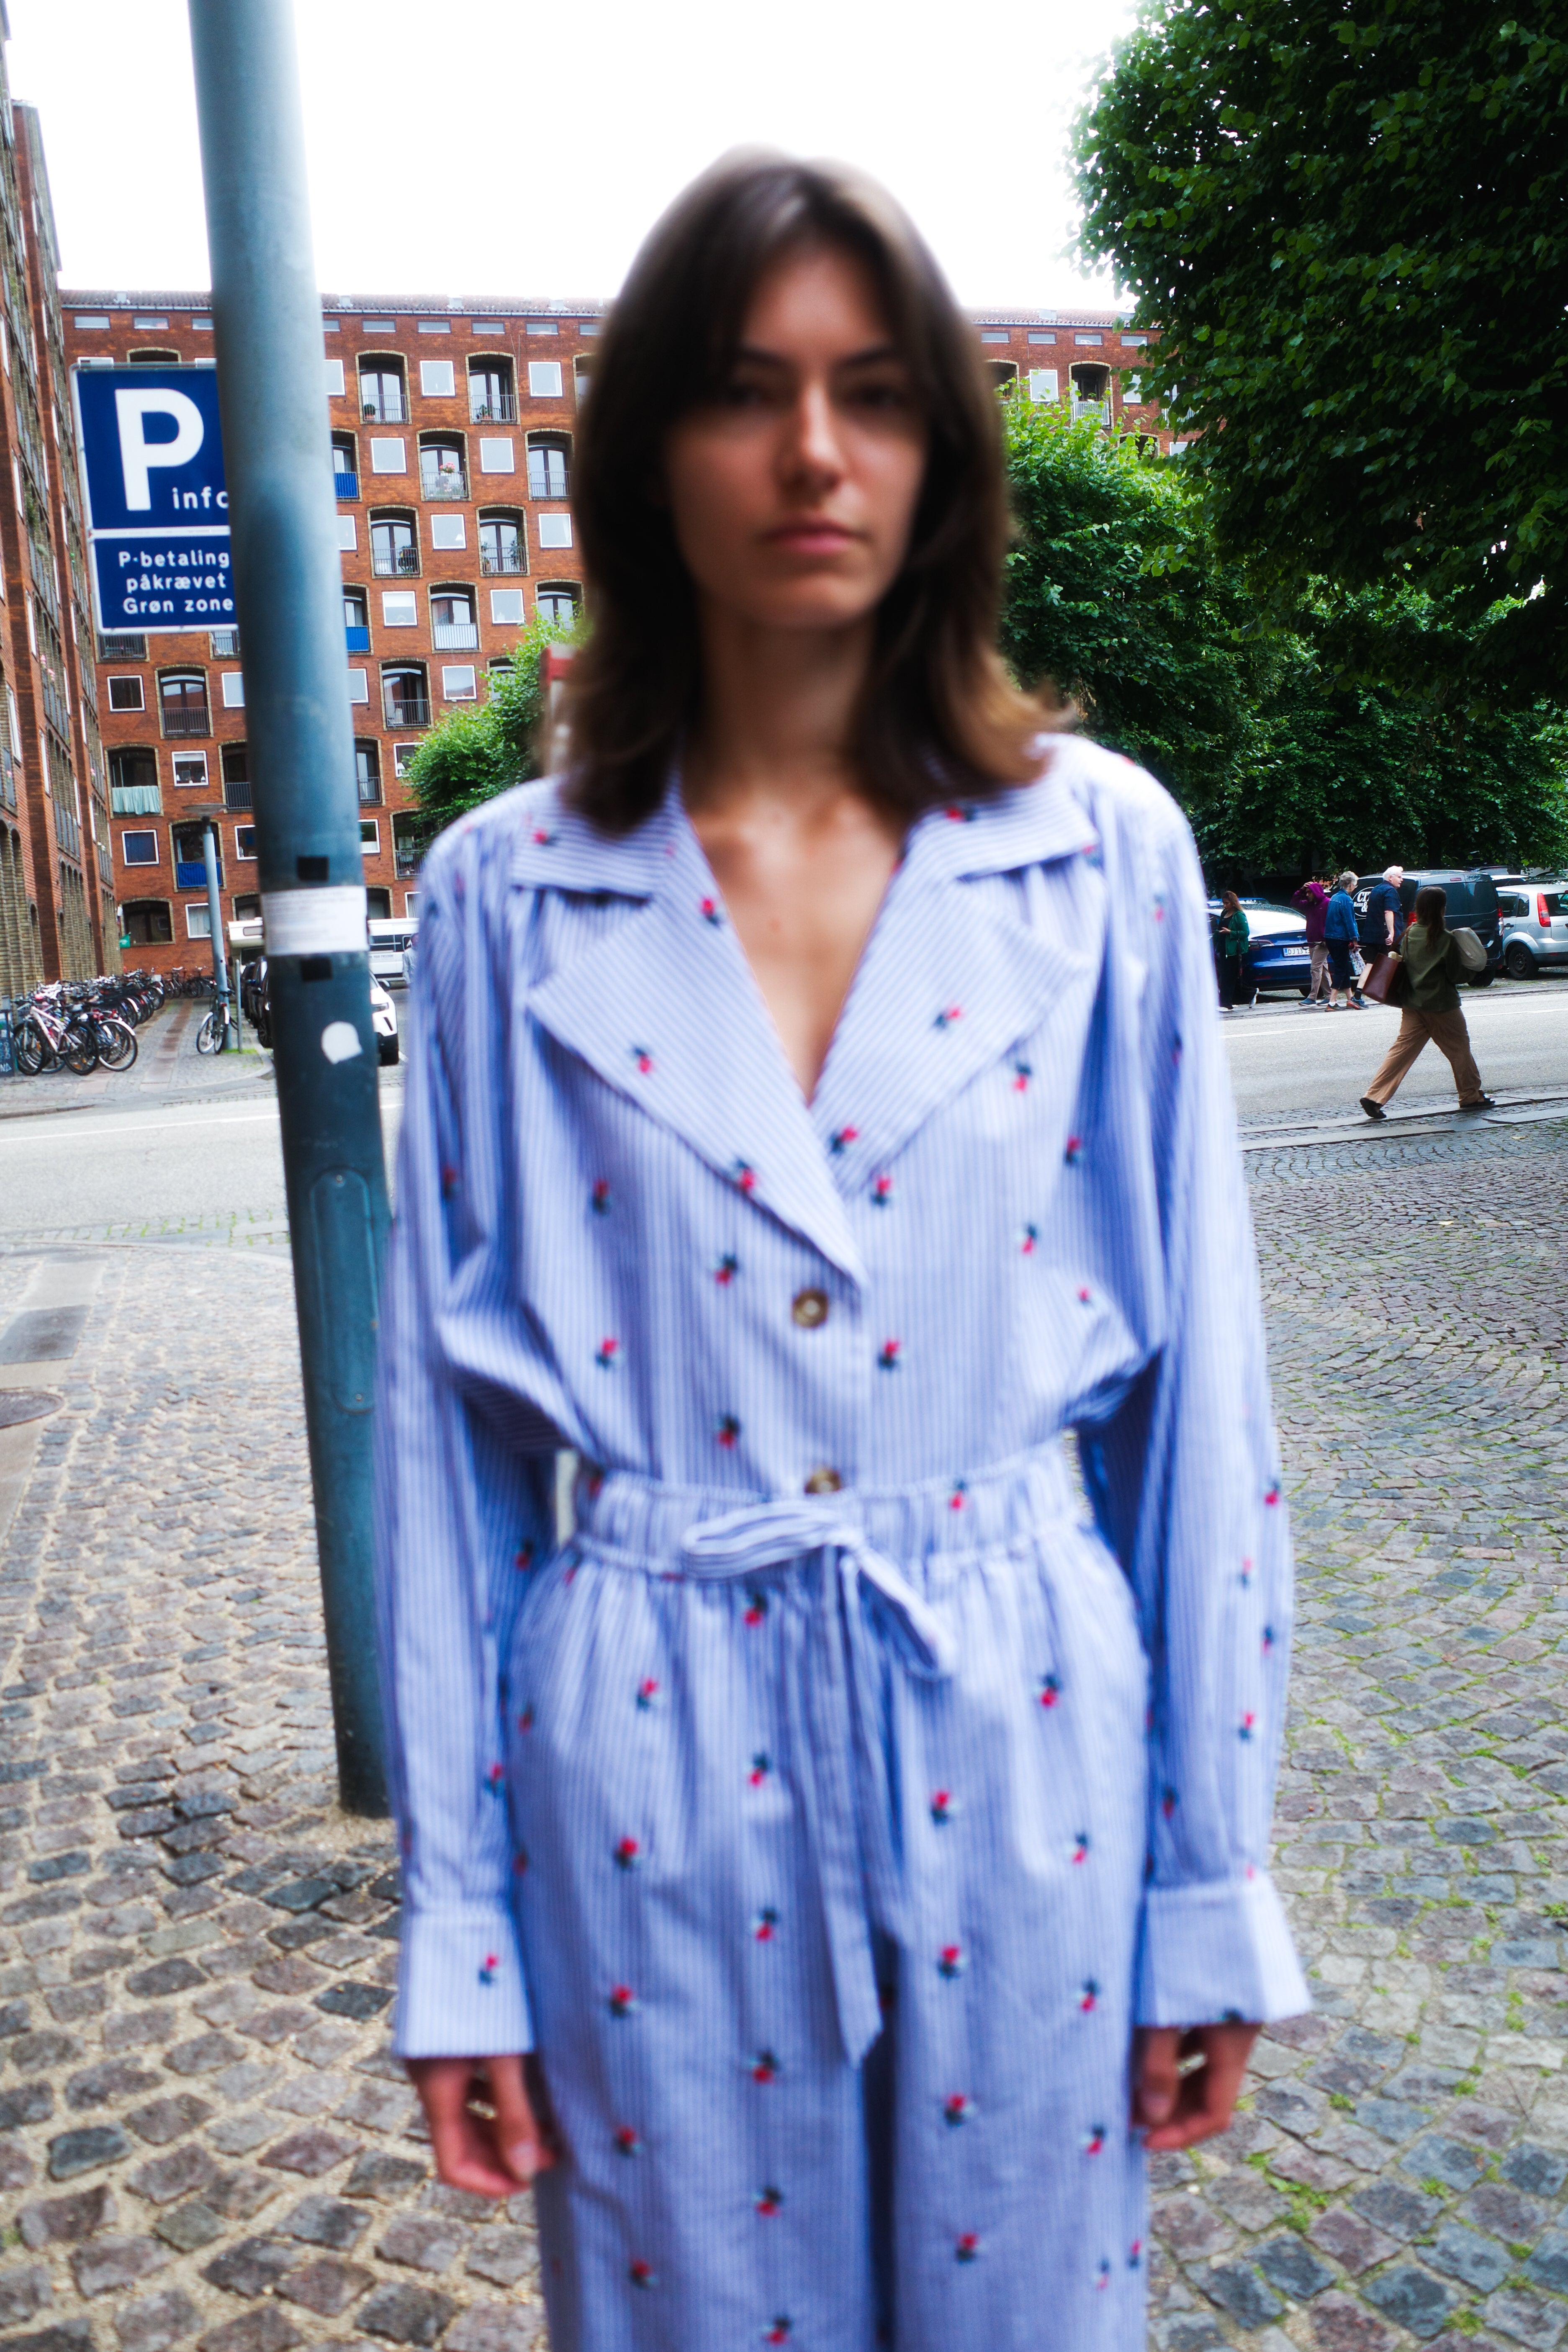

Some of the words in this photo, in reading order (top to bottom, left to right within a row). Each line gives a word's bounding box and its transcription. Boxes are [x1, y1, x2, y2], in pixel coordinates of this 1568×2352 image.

[114, 388, 204, 511] P
[118, 549, 230, 568] P-betaling
[126, 572, 226, 594] påkrævet
[123, 597, 174, 614] Grøn
[185, 598, 234, 612] zone
